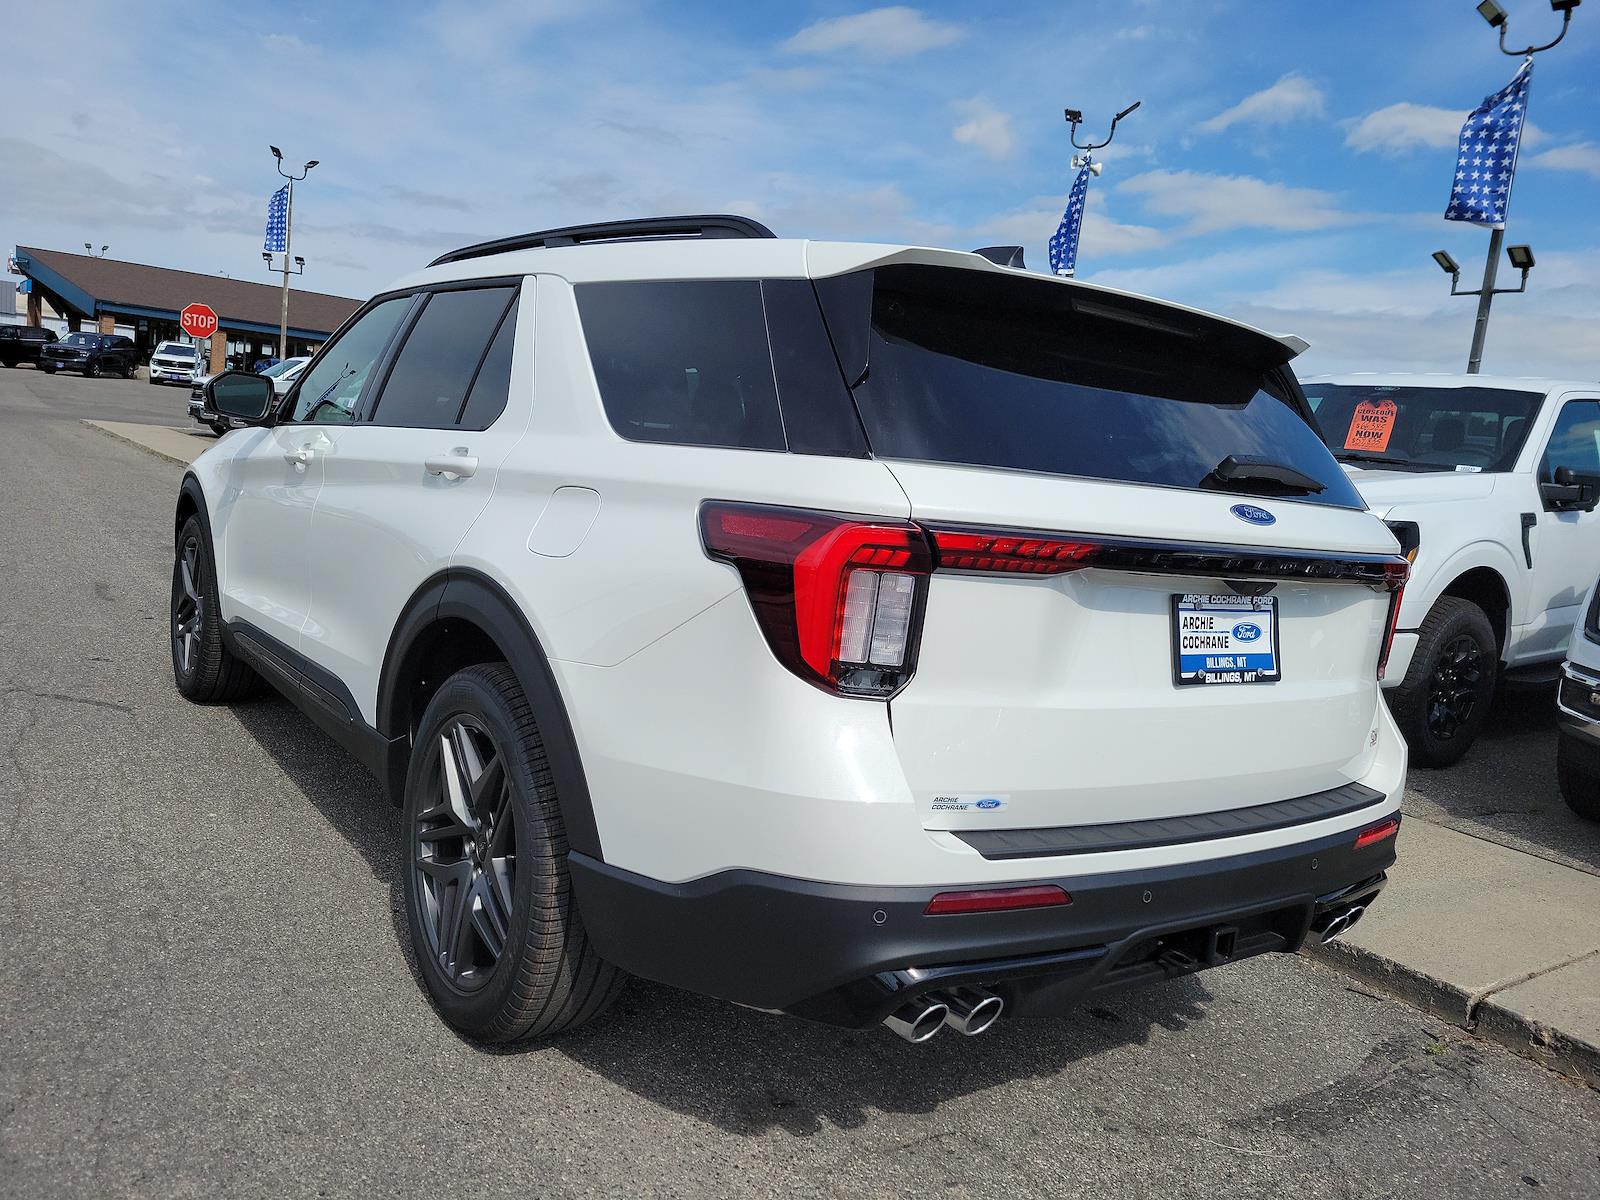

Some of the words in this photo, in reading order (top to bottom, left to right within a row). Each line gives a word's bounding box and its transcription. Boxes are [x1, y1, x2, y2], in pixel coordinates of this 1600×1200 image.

[183, 313, 216, 329] STOP
[1361, 415, 1388, 423] WAS
[1355, 430, 1384, 439] NOW
[1182, 594, 1210, 604] ARCHIE
[1210, 595, 1252, 605] COCHRANE
[1252, 596, 1274, 605] FORD
[1183, 616, 1214, 630] ARCHIE
[1182, 636, 1229, 649] COCHRANE
[1206, 657, 1236, 669] BILLINGS,
[1236, 656, 1247, 668] MT
[1205, 673, 1242, 684] BILLINGS,
[1243, 672, 1257, 682] MT
